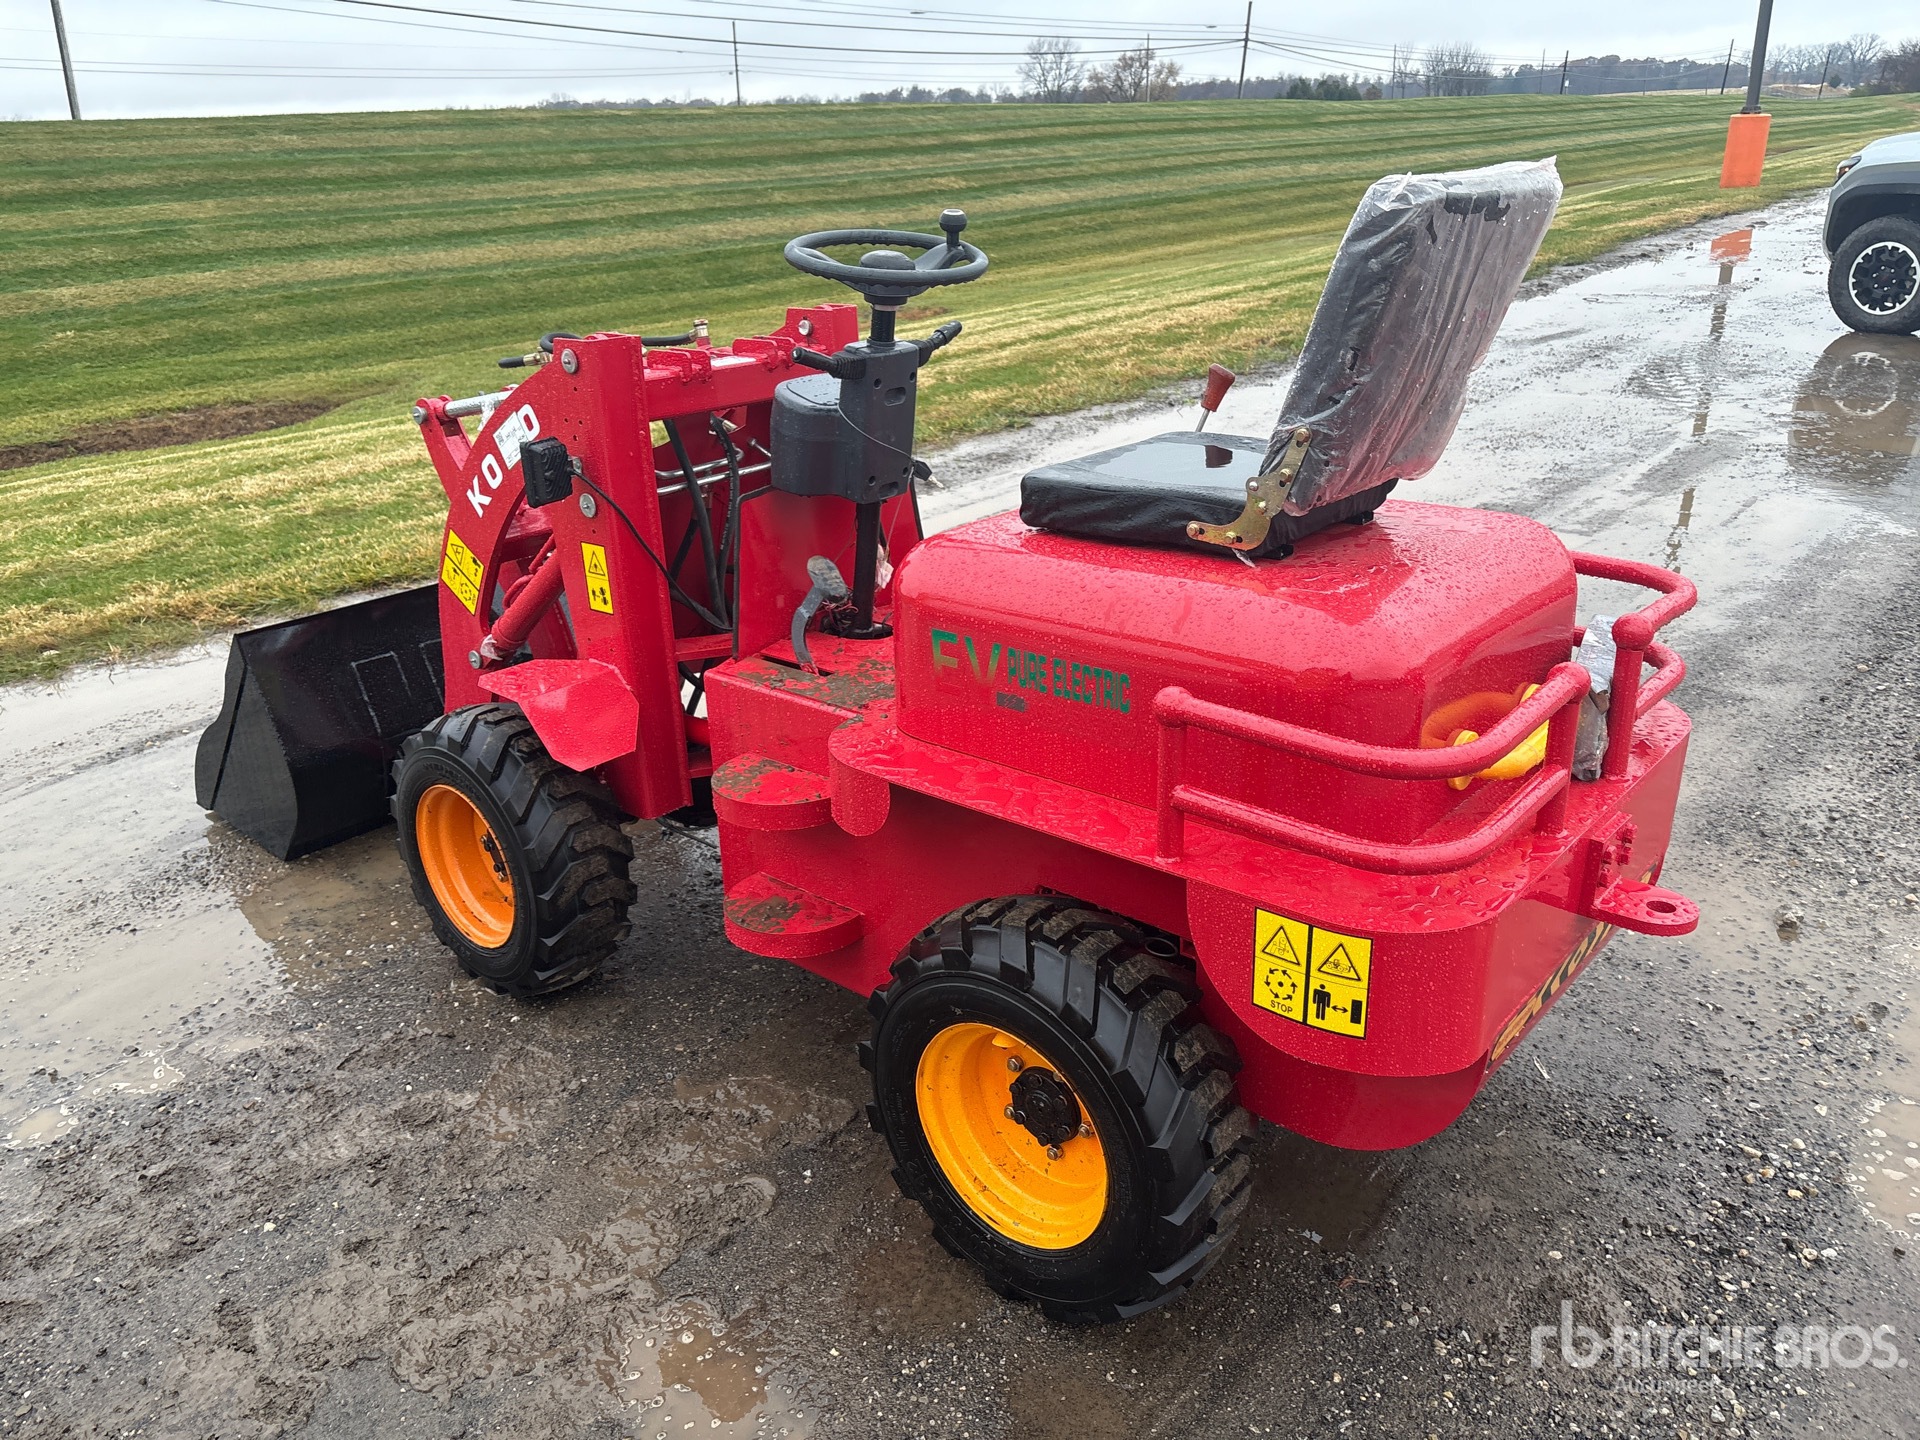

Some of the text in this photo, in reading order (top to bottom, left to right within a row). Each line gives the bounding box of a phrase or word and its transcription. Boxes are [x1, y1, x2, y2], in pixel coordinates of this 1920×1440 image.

[466, 403, 541, 518] KOO
[931, 628, 1131, 714] EV PURE ELECTRIC
[1270, 1000, 1293, 1013] STOP
